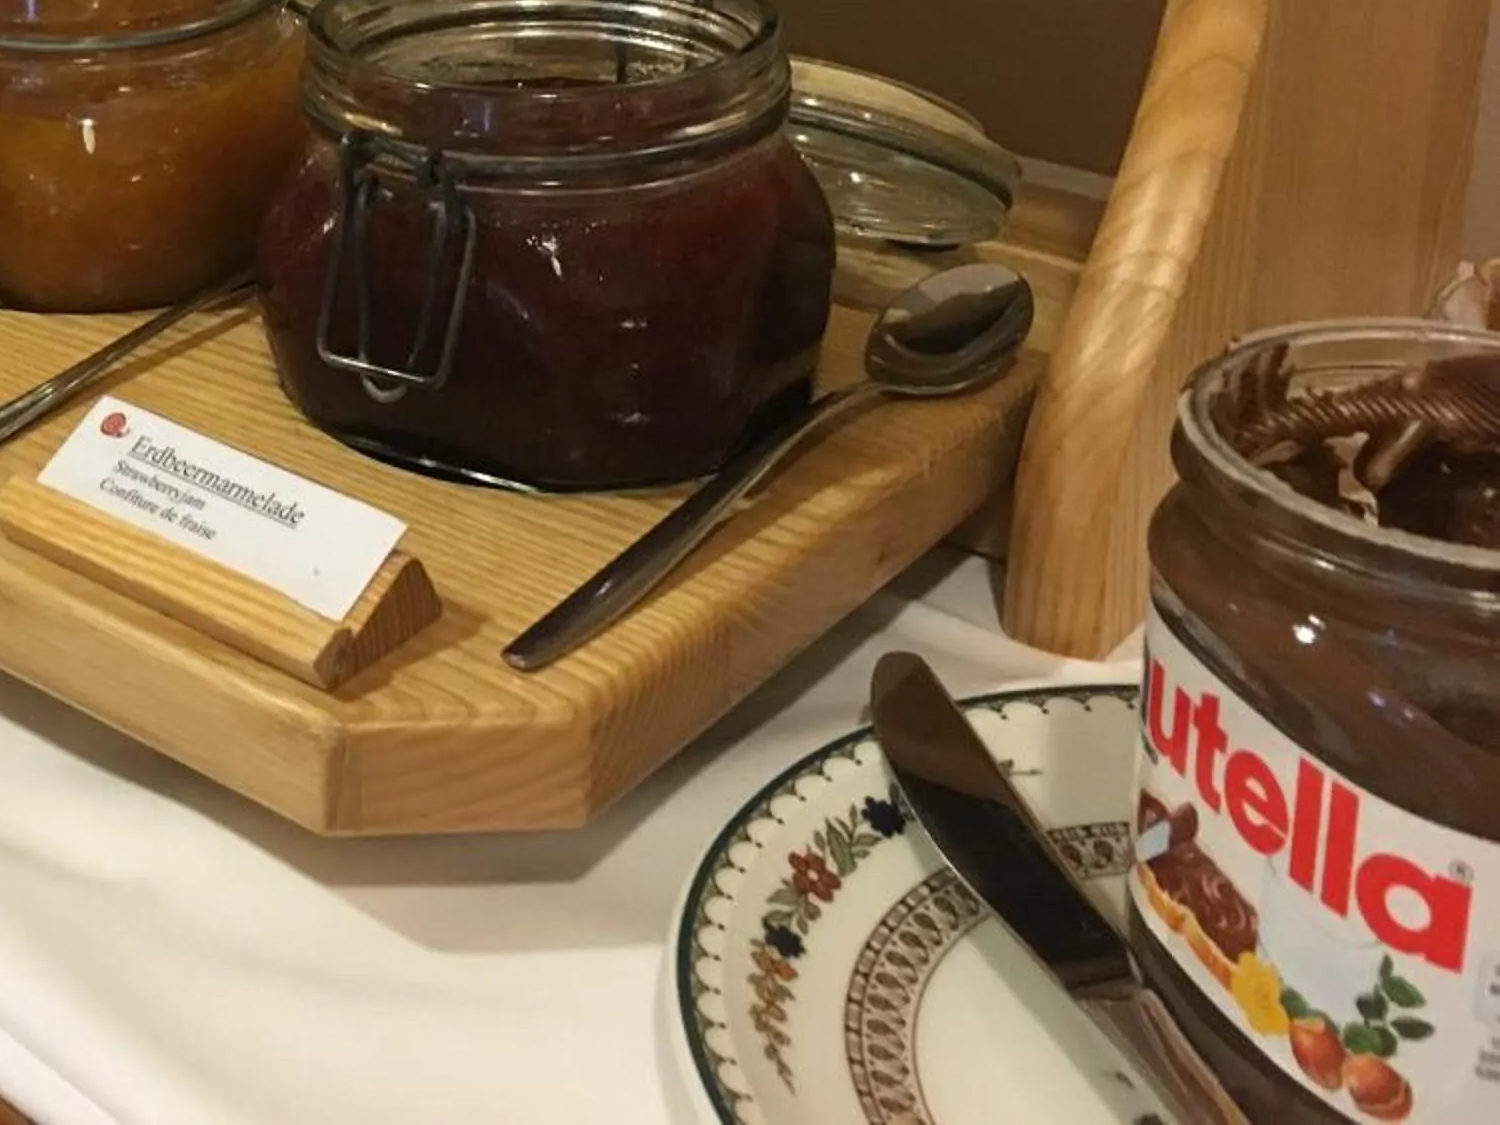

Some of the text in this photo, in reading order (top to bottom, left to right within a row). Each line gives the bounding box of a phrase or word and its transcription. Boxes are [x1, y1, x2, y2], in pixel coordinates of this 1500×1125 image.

[99, 476, 218, 542] Confiture de fraise
[128, 433, 306, 529] Erdbeermarmelade
[1141, 653, 1474, 976] utella
